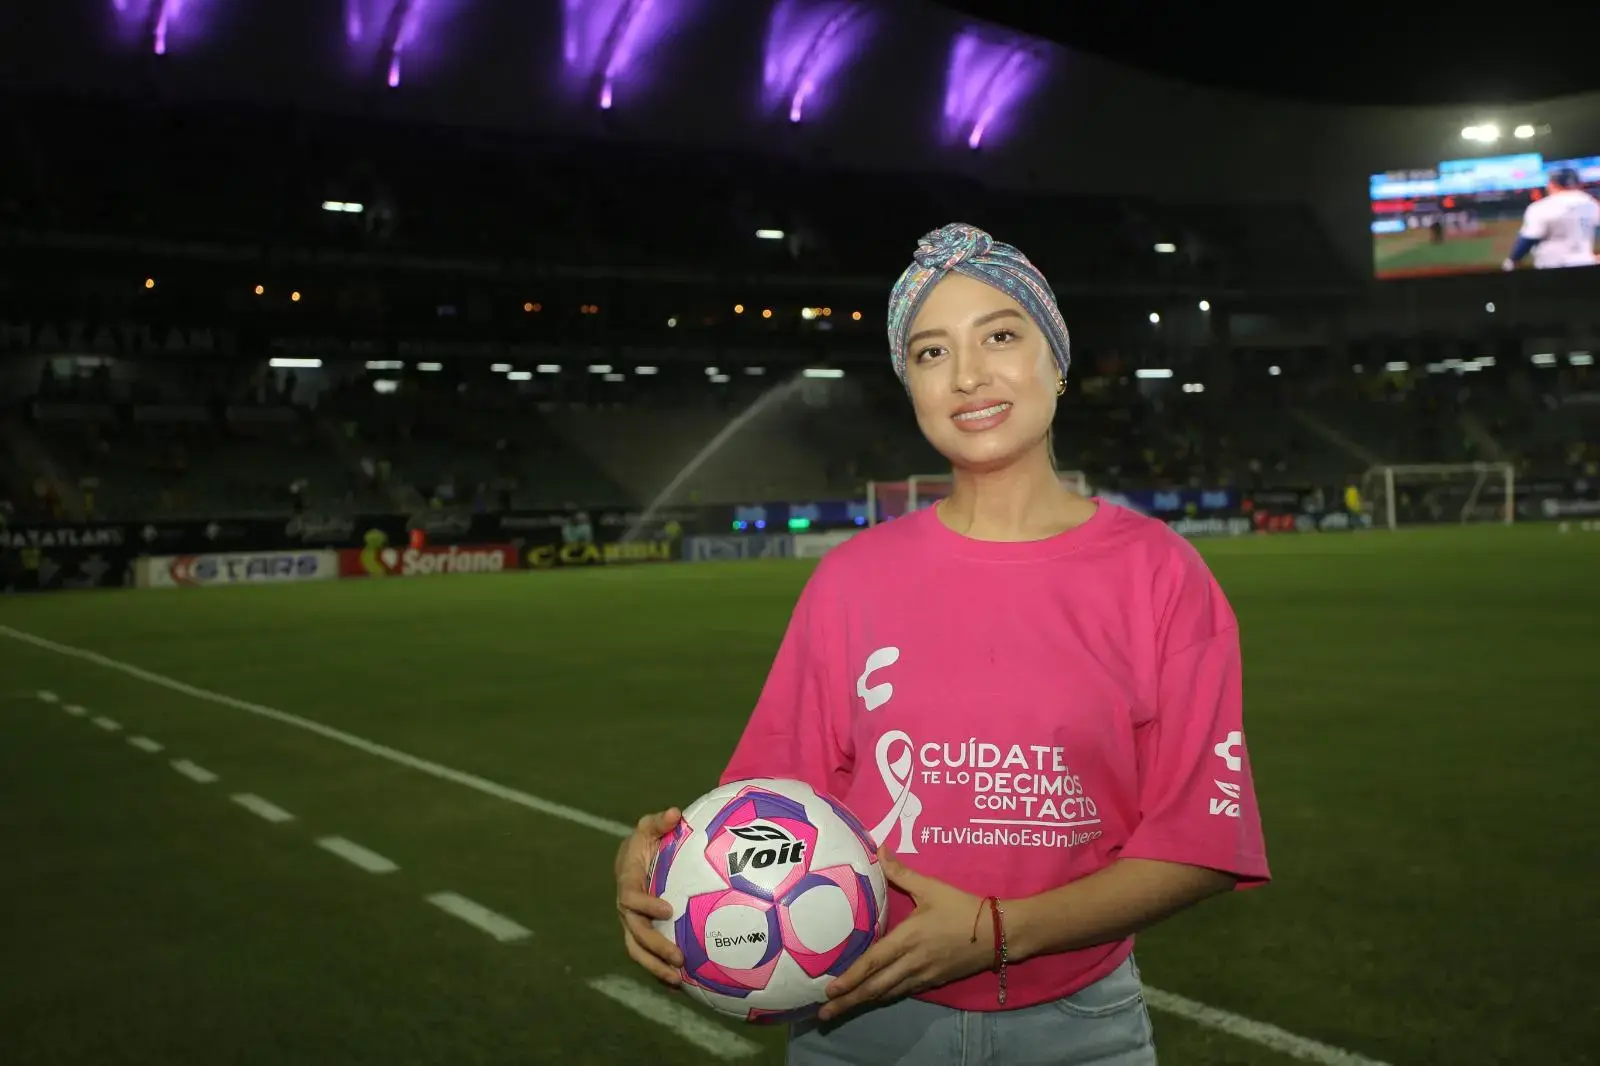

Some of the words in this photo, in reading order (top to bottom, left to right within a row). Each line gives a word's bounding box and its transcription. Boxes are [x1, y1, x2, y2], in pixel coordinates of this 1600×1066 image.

[195, 554, 319, 581] STARS
[402, 545, 505, 575] Soriana
[921, 771, 941, 784] TE
[945, 771, 970, 785] LO
[974, 771, 1083, 796] DECIMOS
[974, 795, 1017, 810] CON
[1019, 796, 1097, 820] TACTO
[727, 840, 805, 876] Voit
[706, 930, 722, 939] LIGA
[715, 935, 747, 948] BBVA
